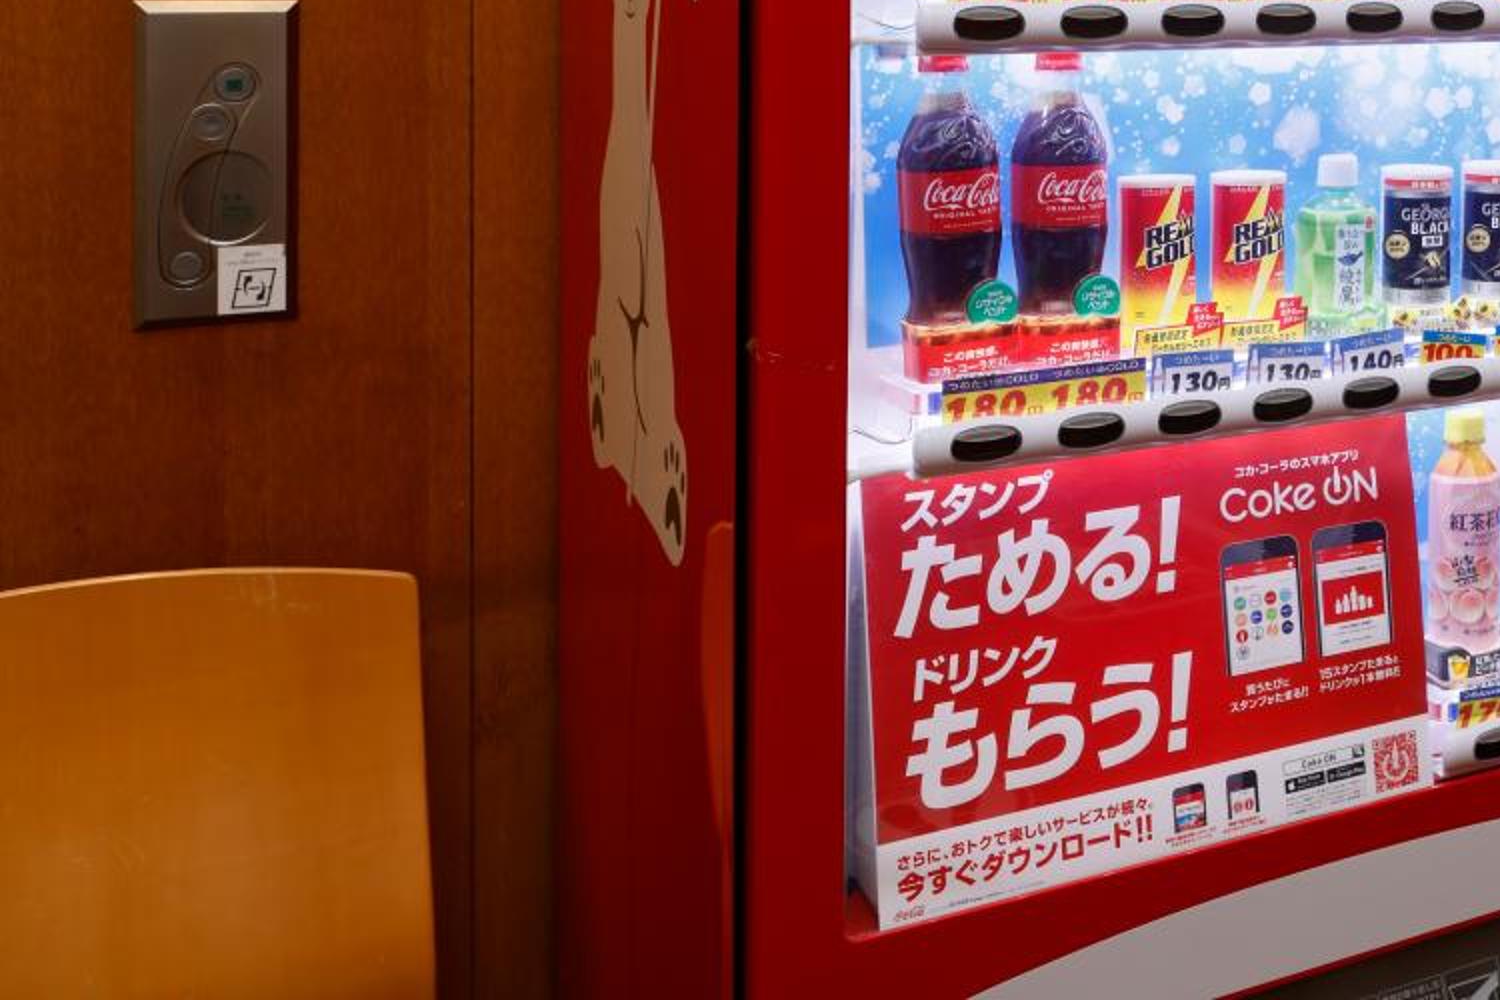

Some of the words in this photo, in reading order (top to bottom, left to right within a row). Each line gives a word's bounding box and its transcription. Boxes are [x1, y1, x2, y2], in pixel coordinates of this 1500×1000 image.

[1145, 216, 1195, 248] REAL
[1235, 213, 1285, 244] REAL
[1171, 370, 1231, 394] 130円
[1349, 348, 1405, 371] 140円
[1233, 449, 1360, 478] コカ・コーラのスマホアプリ
[901, 468, 1054, 532] スタンプ
[1219, 481, 1317, 523] Coke
[1322, 465, 1379, 506] ON
[894, 496, 1182, 641] ためる!
[912, 635, 1058, 702] ドリンク
[905, 651, 1194, 811] もらう!
